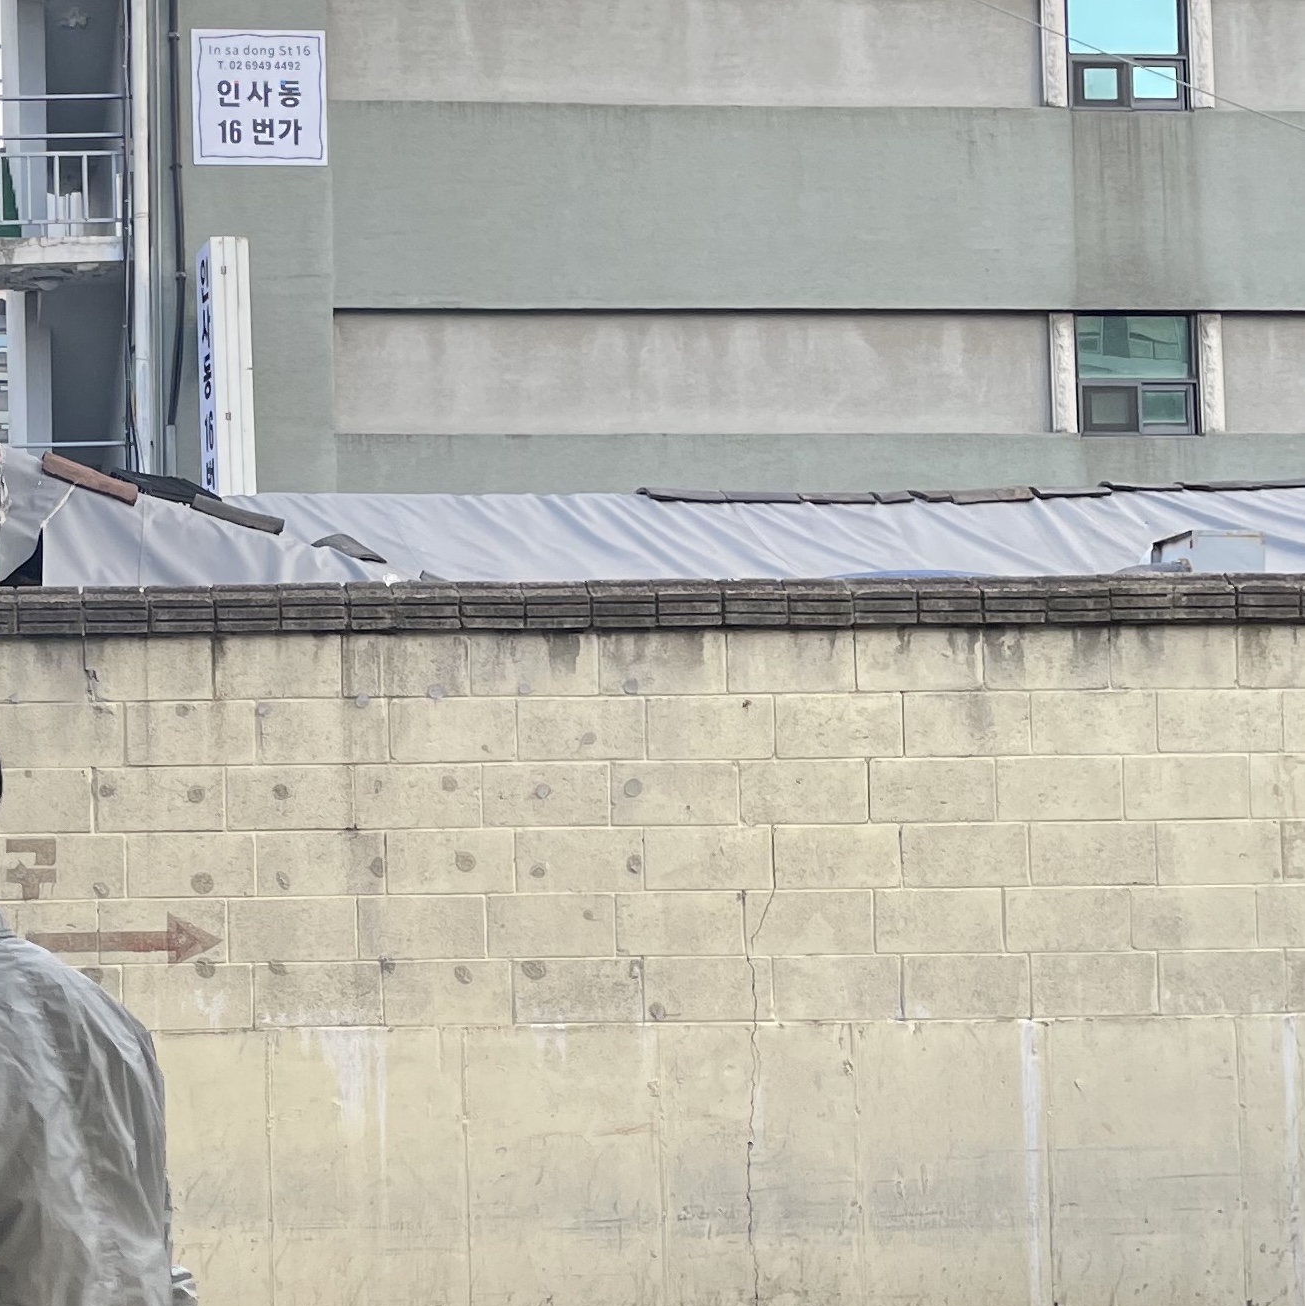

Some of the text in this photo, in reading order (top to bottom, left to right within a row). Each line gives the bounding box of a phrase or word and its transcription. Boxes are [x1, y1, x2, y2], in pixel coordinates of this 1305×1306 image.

[224, 46, 239, 55] sa
[243, 45, 275, 58] dong
[278, 45, 293, 56] St
[296, 45, 311, 56] 16
[229, 61, 243, 70] 02
[245, 61, 272, 71] 6949
[274, 61, 301, 71] 4492
[217, 118, 303, 146] 16 번가
[204, 410, 214, 453] 16
